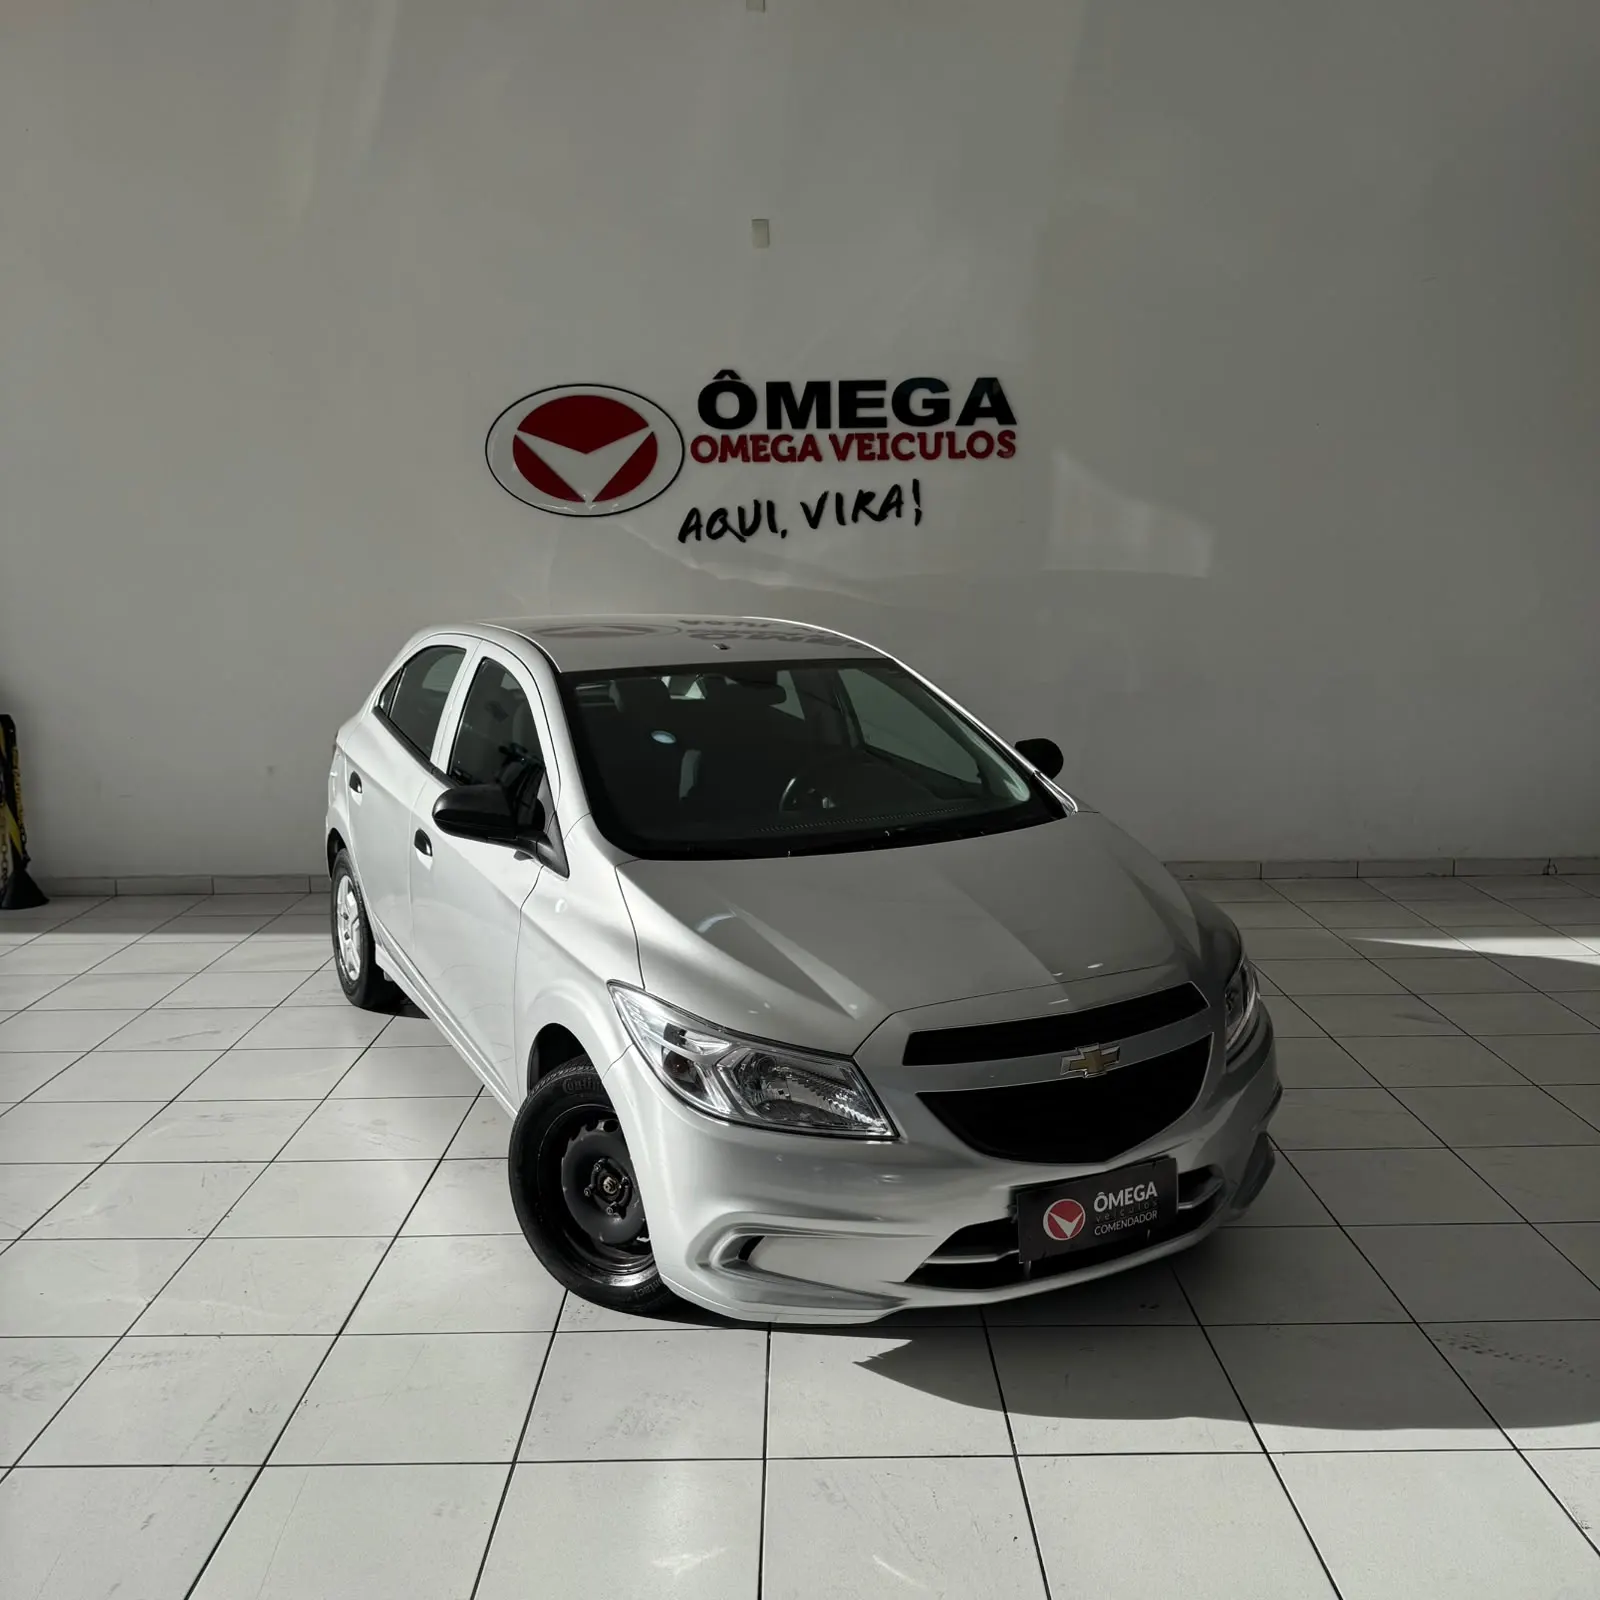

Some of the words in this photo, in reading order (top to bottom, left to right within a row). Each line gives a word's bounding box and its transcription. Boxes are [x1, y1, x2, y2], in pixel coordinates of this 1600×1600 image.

[697, 369, 1018, 430] ÔMEGA
[690, 434, 823, 464] OMEGA
[828, 430, 1017, 462] VEICULOS
[677, 499, 788, 543] AQUI,
[799, 478, 922, 530] VIRA!
[1093, 1181, 1158, 1213] ÔMEGA
[1094, 1210, 1158, 1236] COMENDADOR
